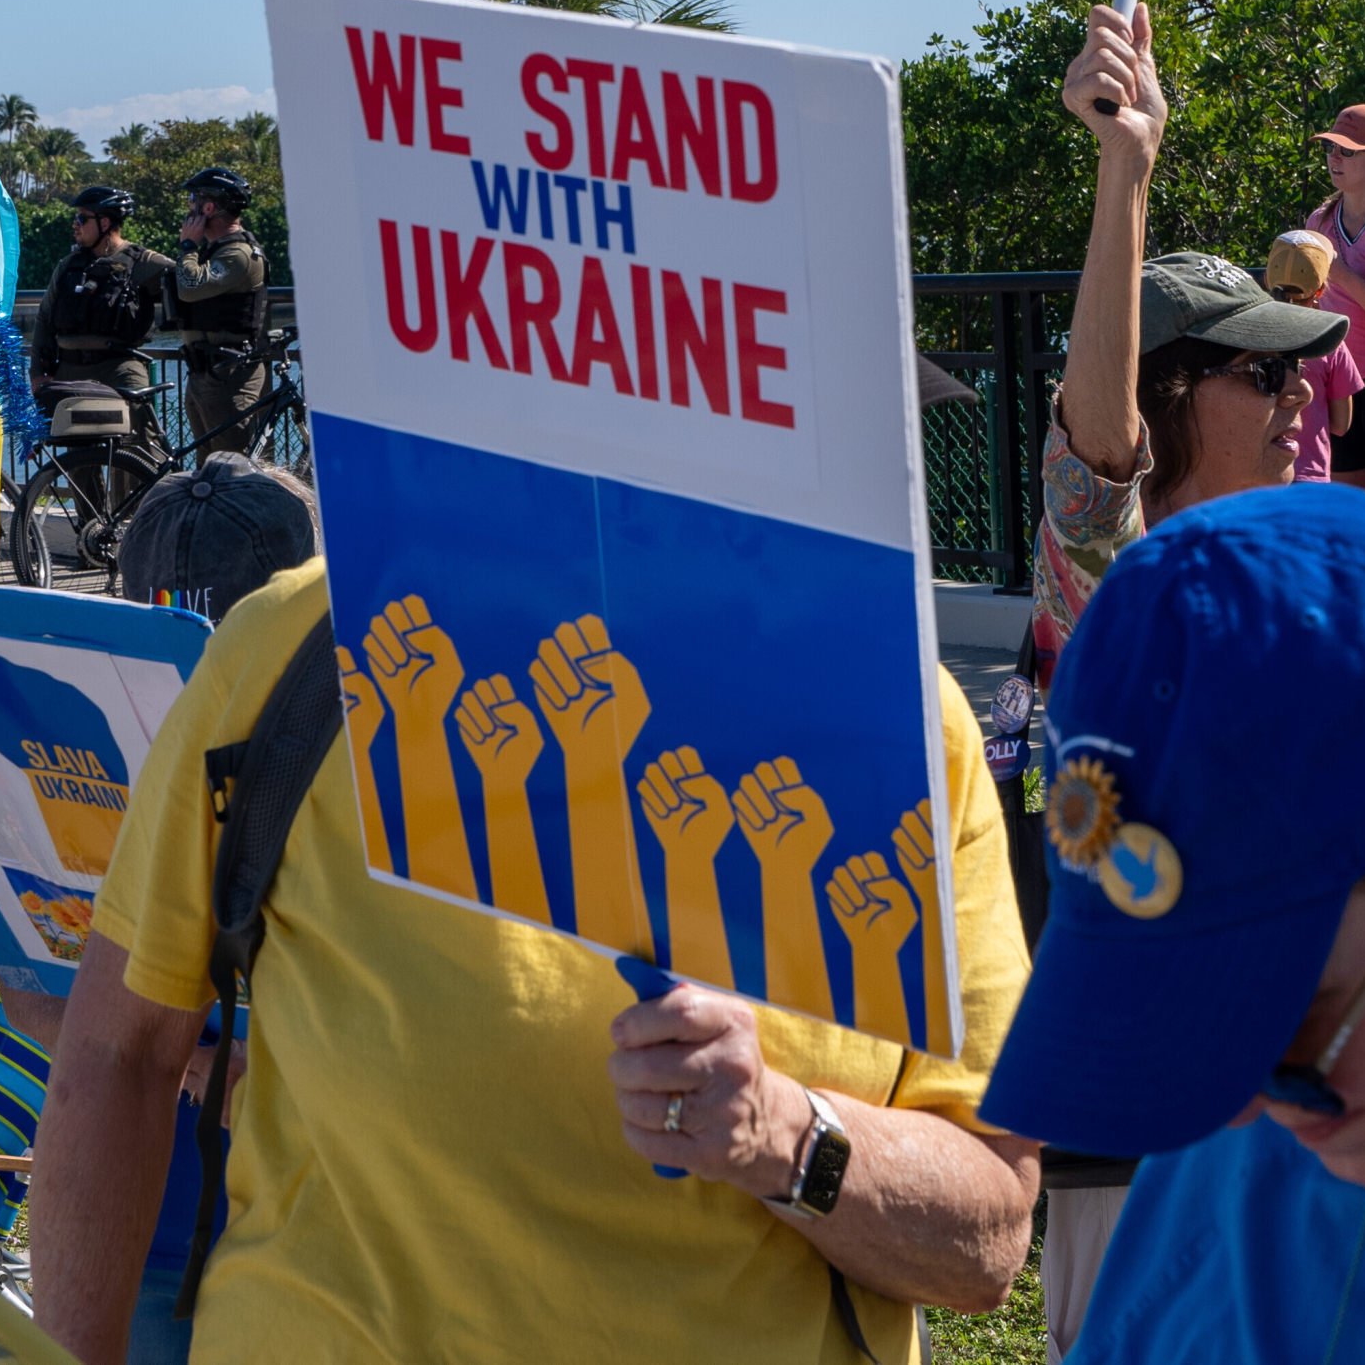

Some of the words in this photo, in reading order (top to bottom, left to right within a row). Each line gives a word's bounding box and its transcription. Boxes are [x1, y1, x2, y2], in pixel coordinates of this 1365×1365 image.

[344, 25, 472, 157] WE
[520, 51, 780, 204] STAND
[470, 160, 637, 255] WITH
[378, 218, 796, 430] UKRAINE
[20, 739, 111, 781] SLAVA
[34, 774, 128, 812] UKRAINI
